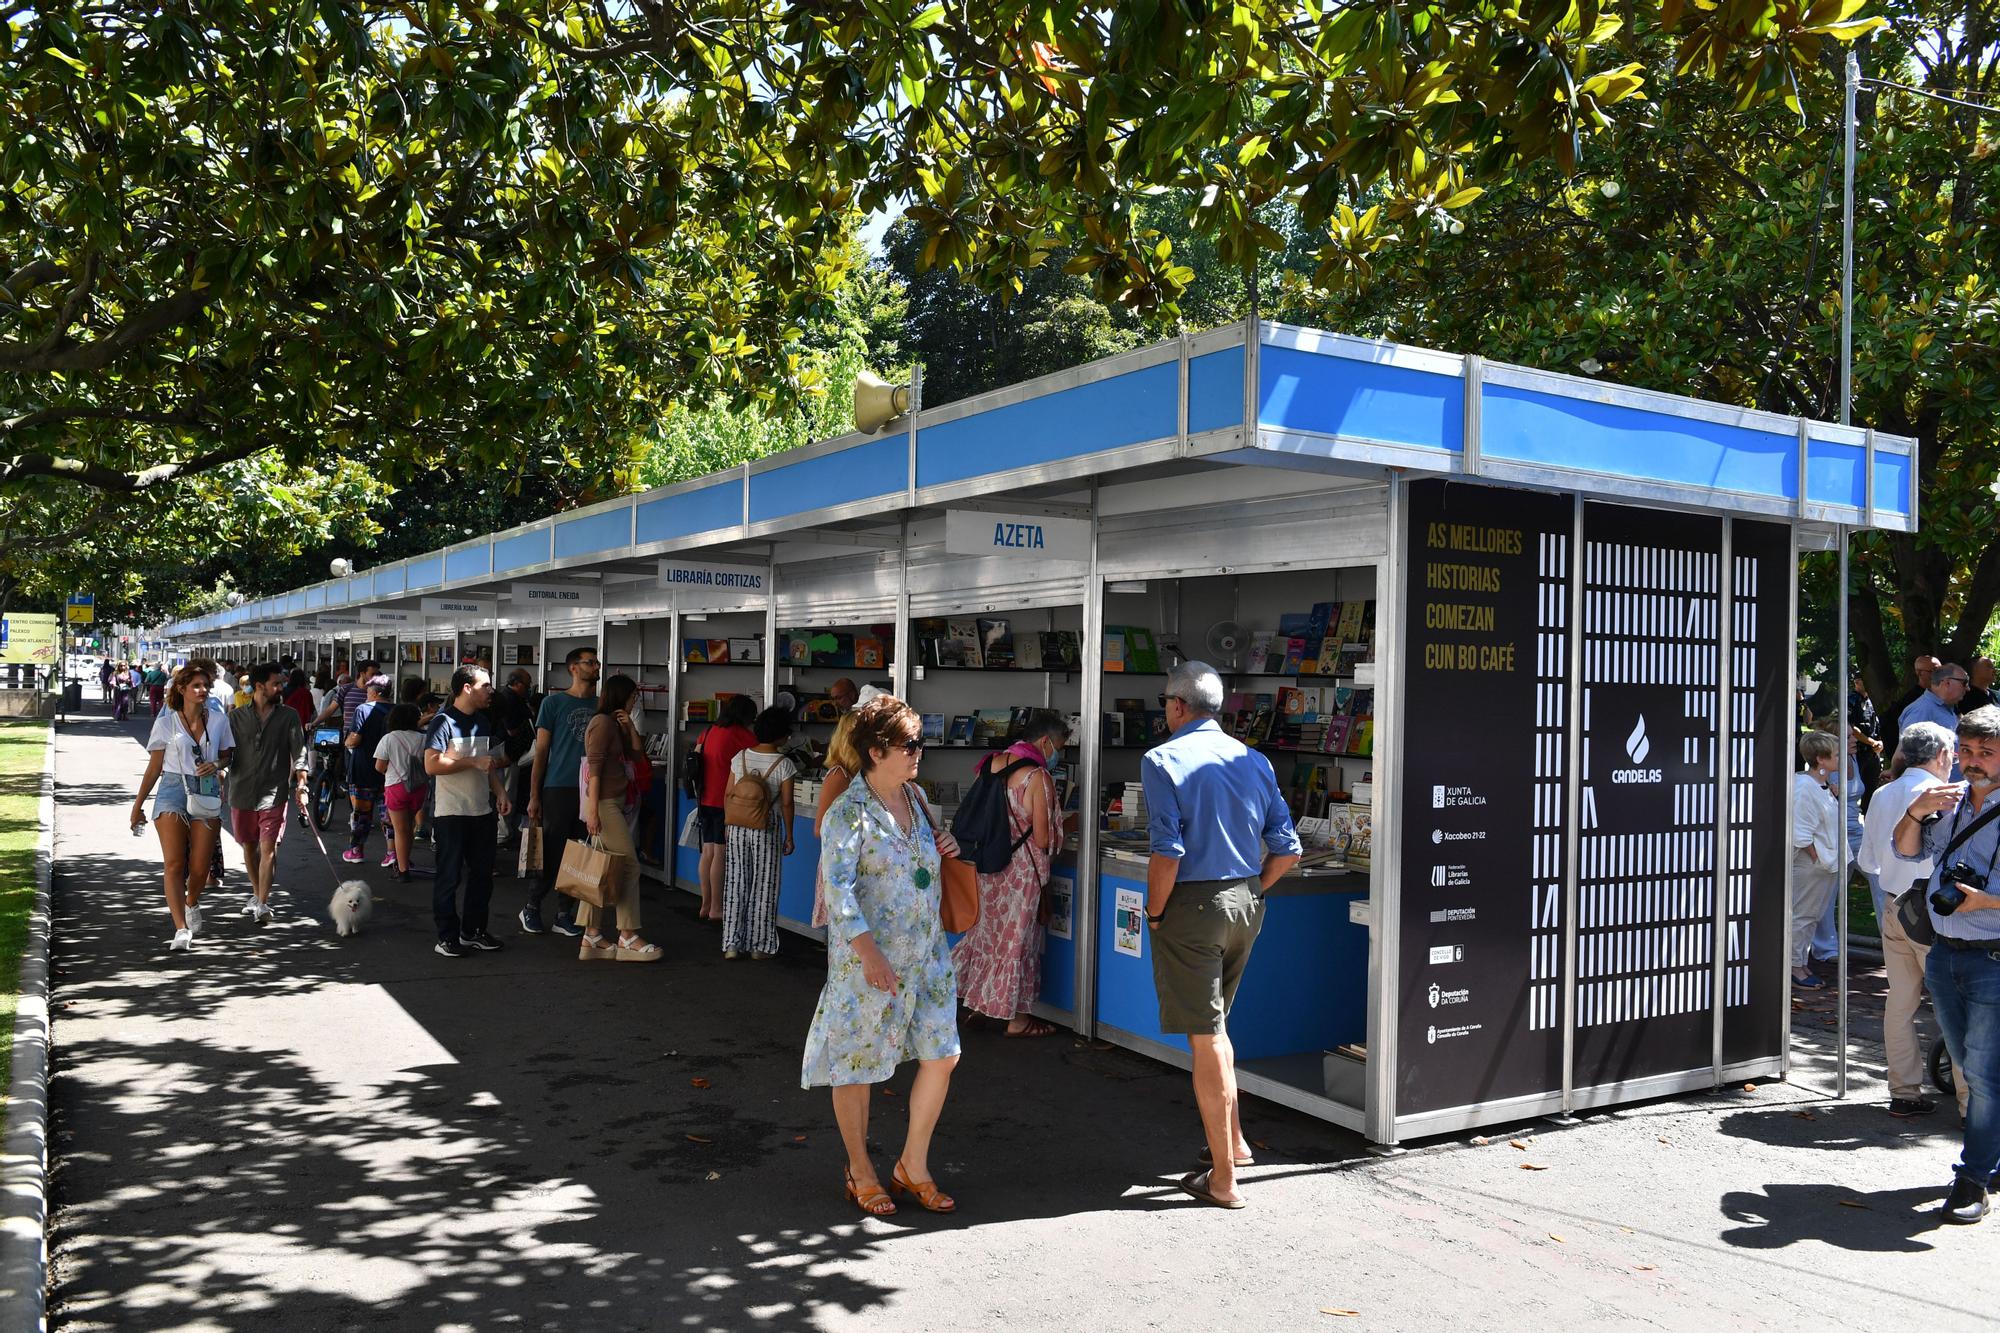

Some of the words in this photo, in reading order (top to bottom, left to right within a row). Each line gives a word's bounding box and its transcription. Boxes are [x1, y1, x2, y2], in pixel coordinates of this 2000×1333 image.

[993, 522, 1044, 549] AZETA
[1427, 522, 1447, 549] AS
[1450, 524, 1522, 555] MELLORES
[667, 568, 712, 586] LIBRARÍA
[714, 571, 762, 589] CORTIZAS
[1427, 562, 1501, 593] HISTORIAS
[528, 590, 558, 600] EDITORIAL
[559, 591, 580, 601] ENEIDA
[1426, 602, 1494, 632] COMEZAN
[1425, 643, 1455, 670] CUN
[1458, 645, 1477, 671] BO
[1480, 642, 1515, 672] CAFÉ
[1611, 769, 1662, 784] CANDELAS
[1446, 786, 1472, 796] XUNTA
[1446, 797, 1456, 806] DE
[1457, 796, 1487, 806] GALICIA
[1444, 831, 1472, 841] Xacobeo
[1447, 906, 1476, 916] DEPUTACIÓN
[1441, 988, 1469, 998] Deputación
[1441, 997, 1448, 1005] DA
[1449, 995, 1469, 1004] CORUÑA
